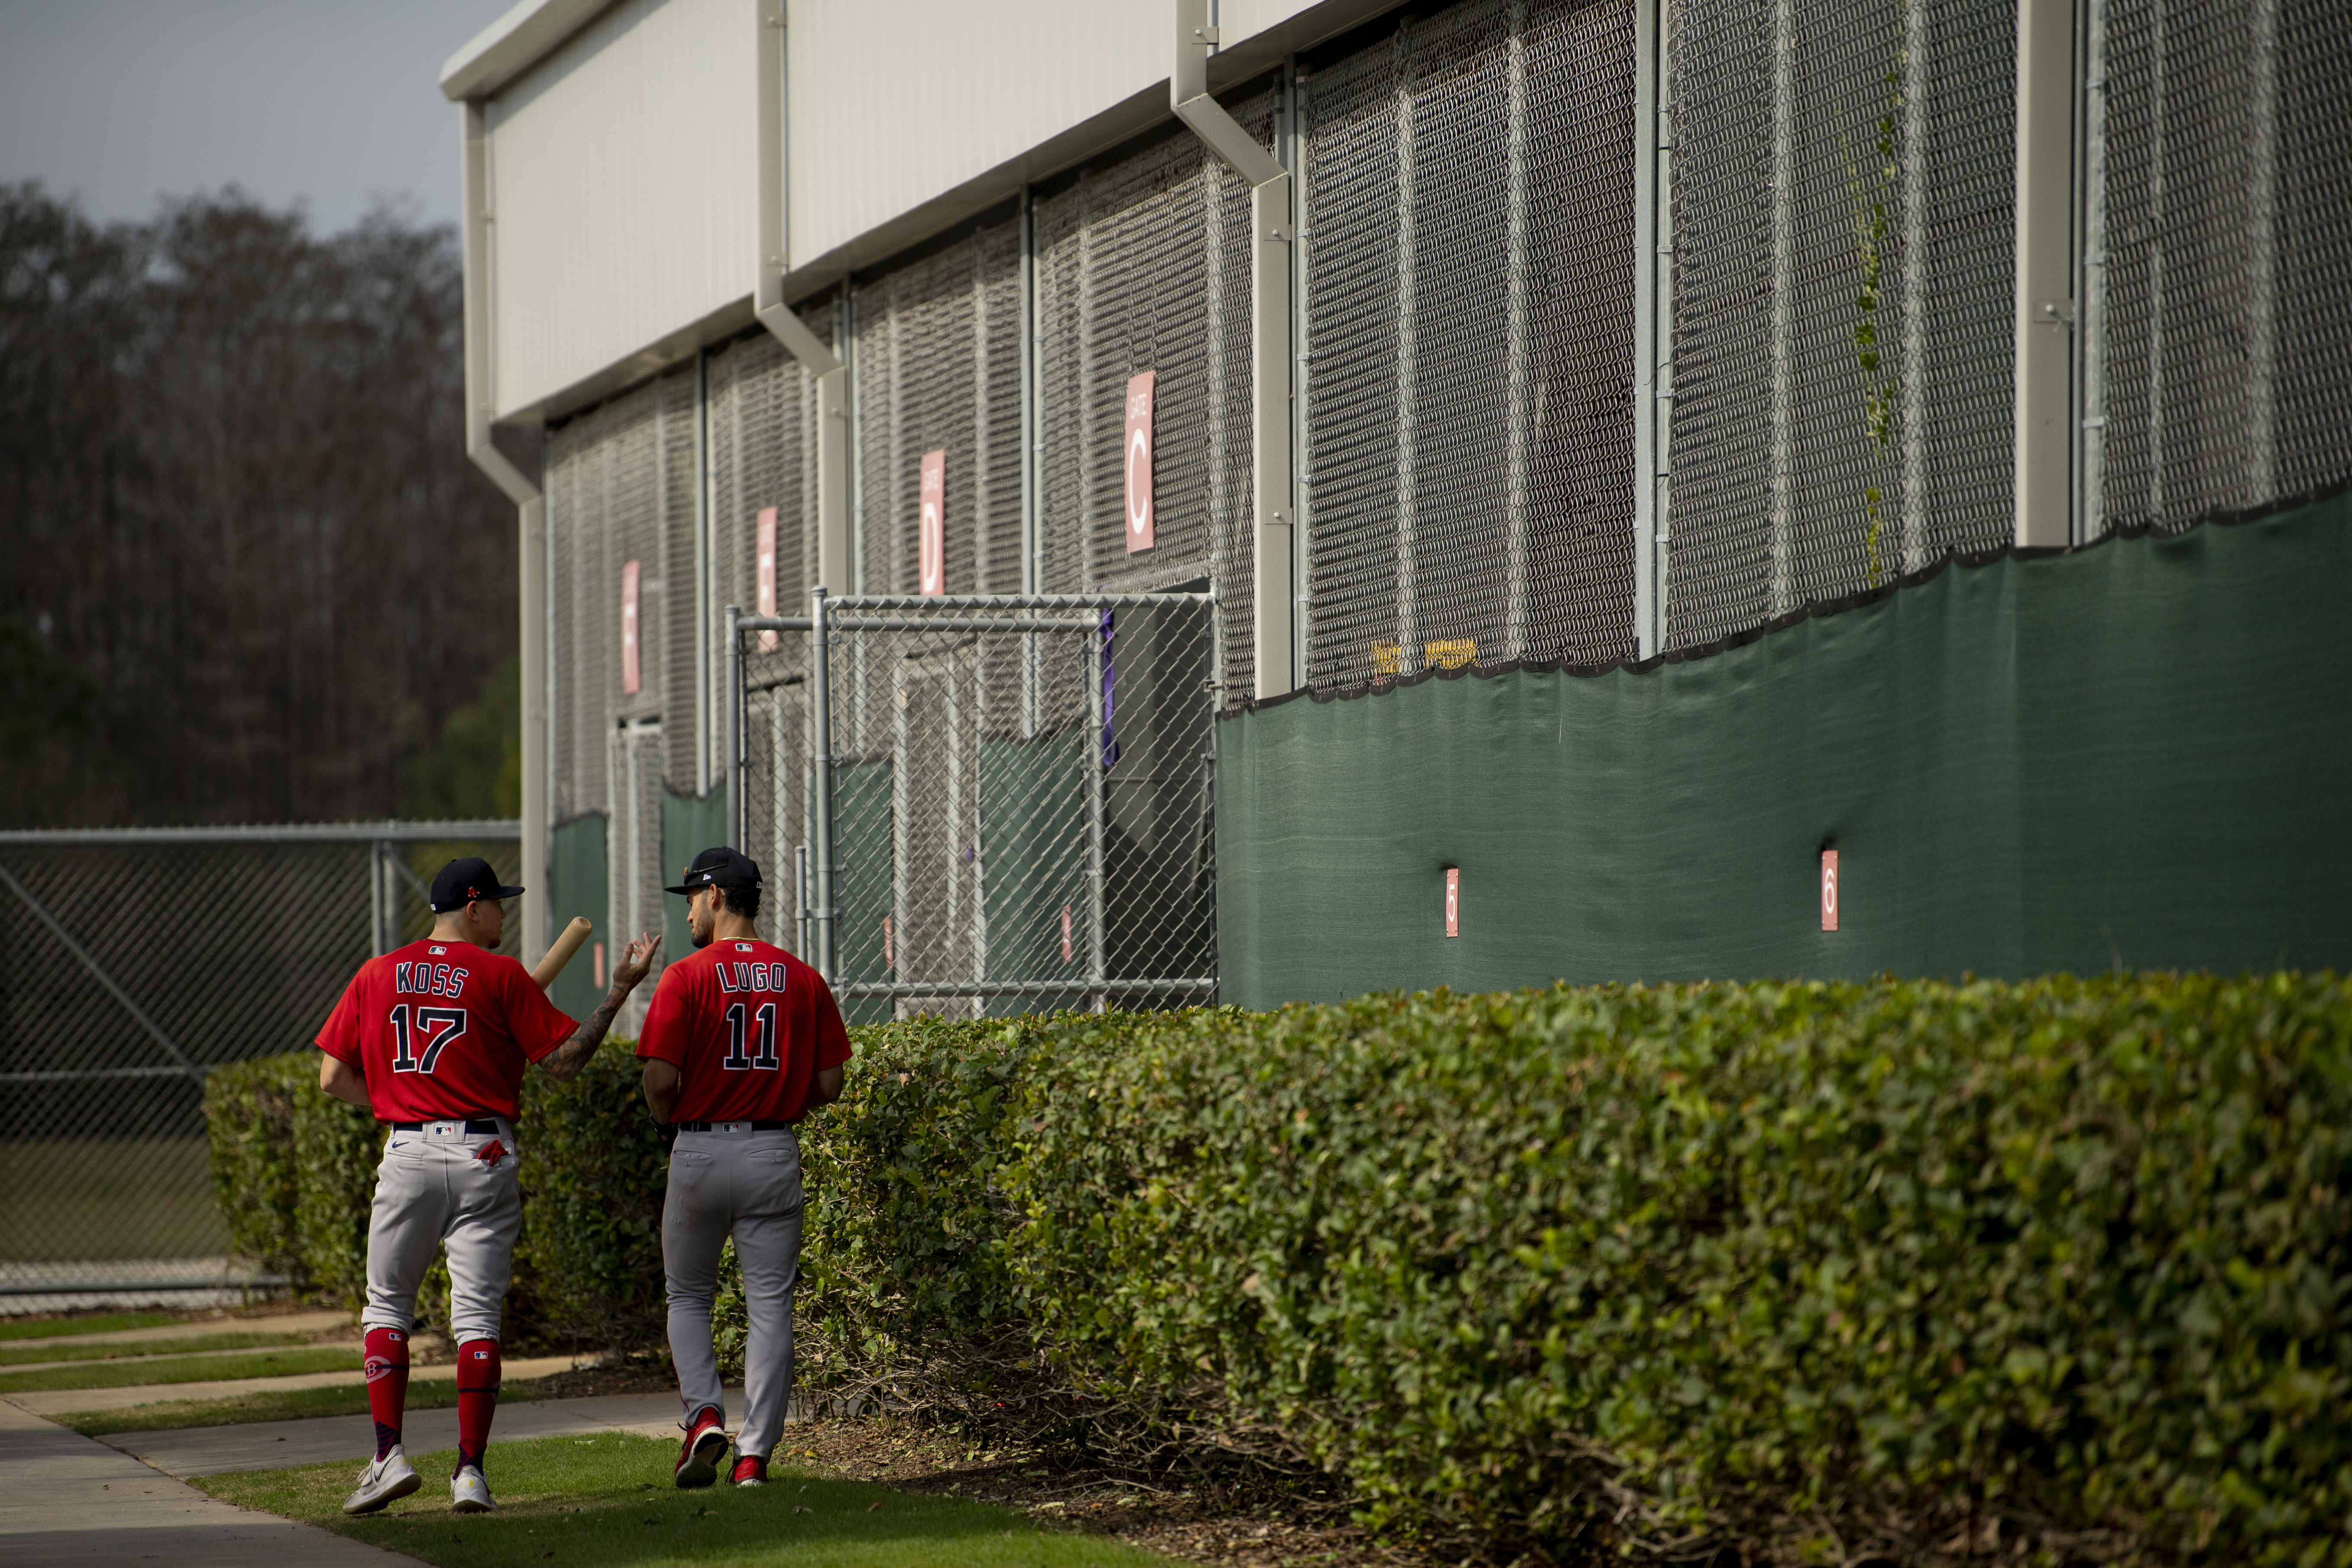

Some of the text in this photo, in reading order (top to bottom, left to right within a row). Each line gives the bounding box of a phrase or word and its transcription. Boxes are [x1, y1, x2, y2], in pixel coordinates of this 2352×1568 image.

[1130, 393, 1147, 419] GATE
[1129, 428, 1147, 534] C
[923, 502, 938, 592] D
[1449, 884, 1455, 922] 5
[1824, 868, 1835, 914] 6
[396, 961, 468, 998] KOSS
[715, 962, 786, 993] LUGO
[390, 1004, 467, 1074] 17
[723, 1003, 779, 1071] 11
